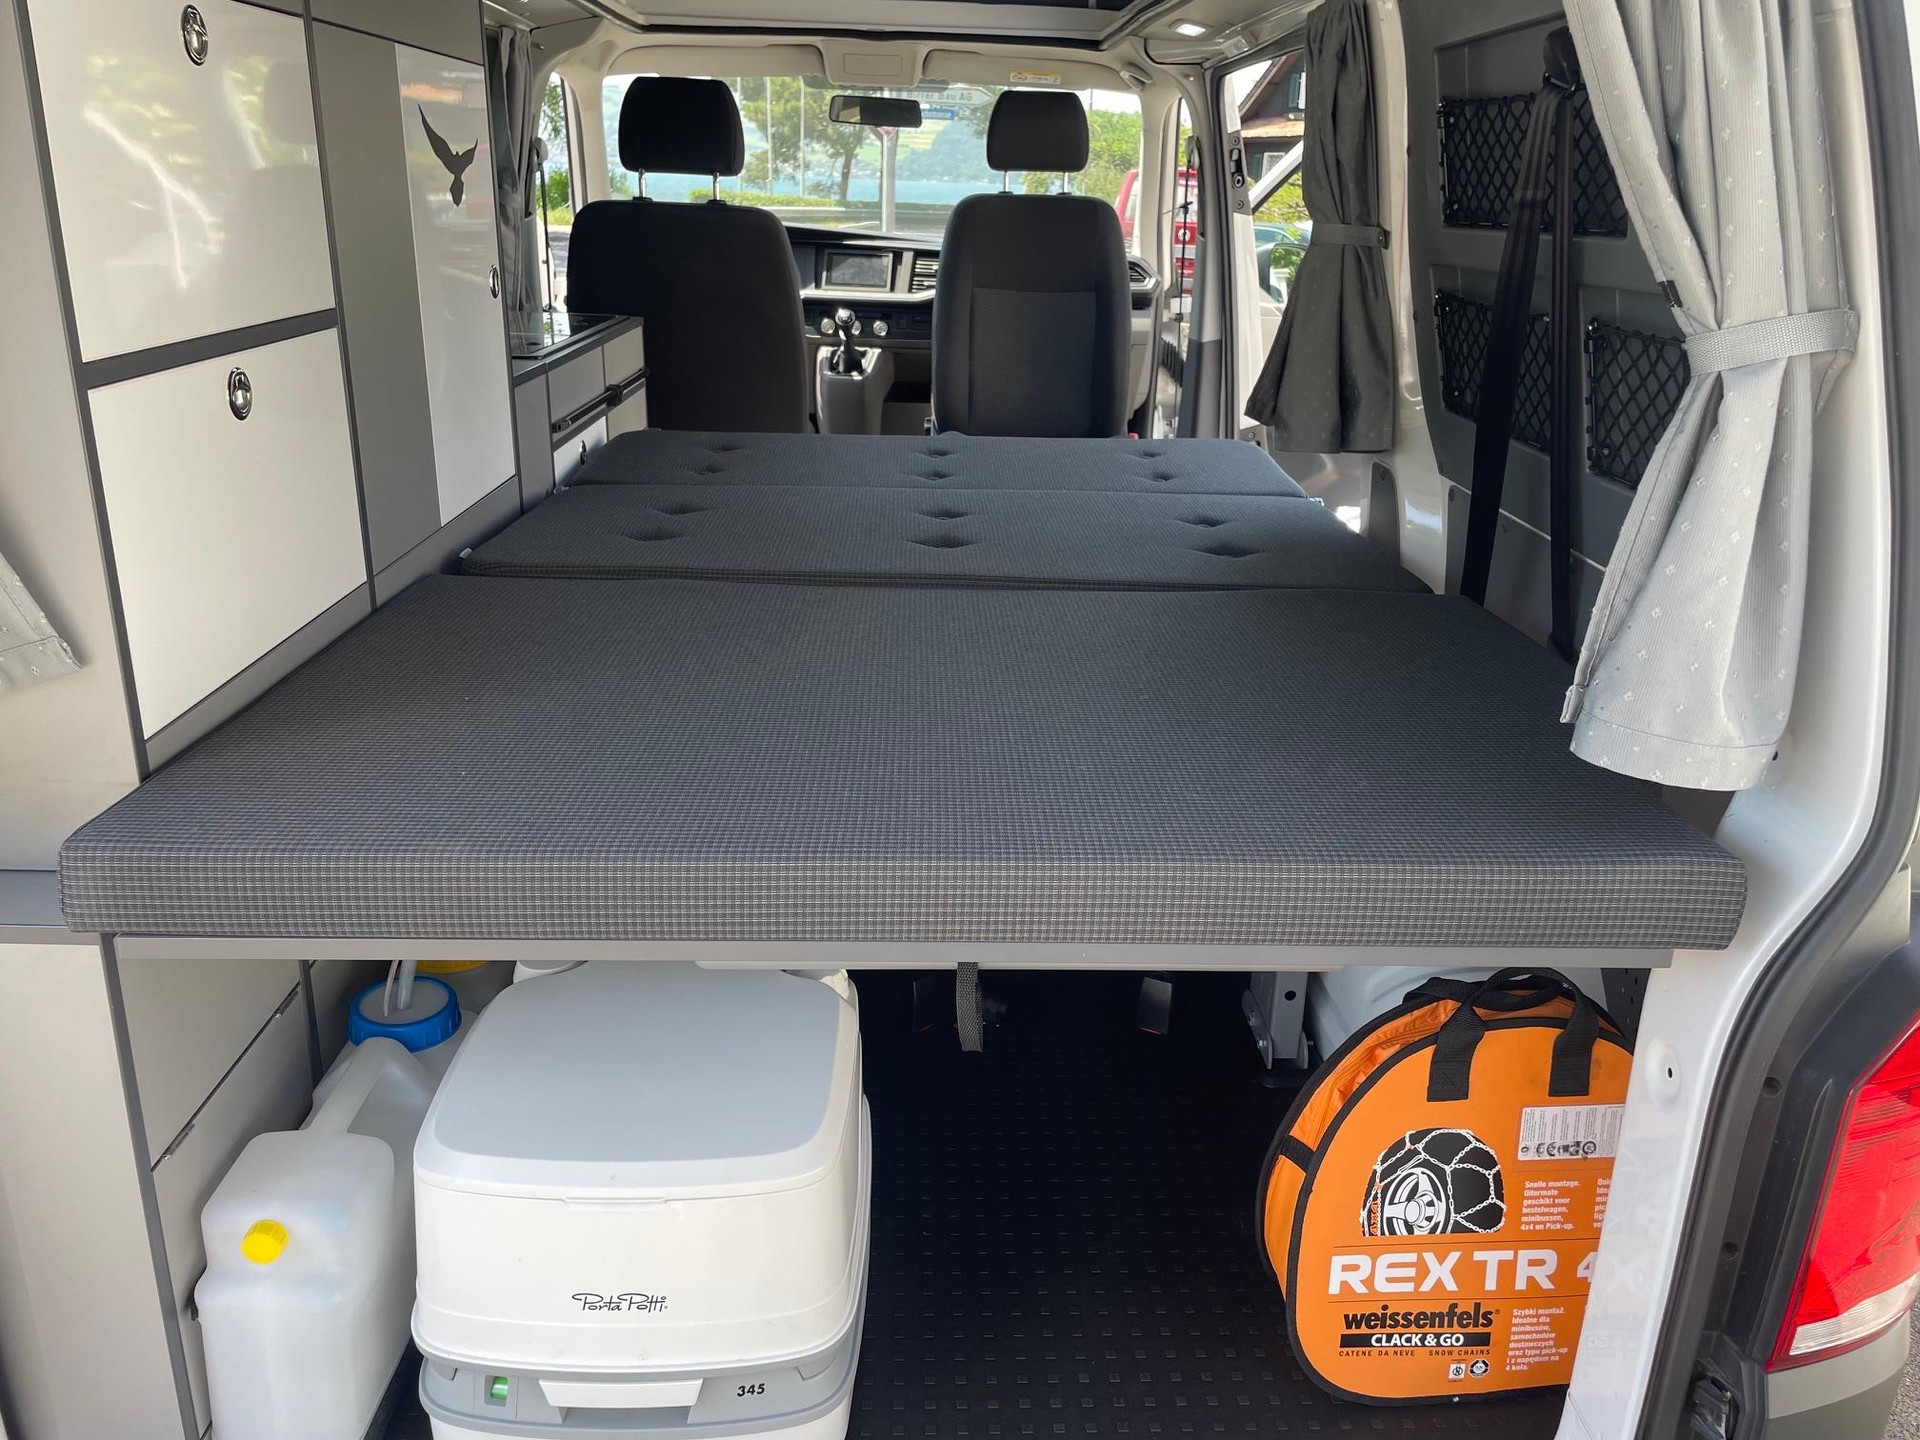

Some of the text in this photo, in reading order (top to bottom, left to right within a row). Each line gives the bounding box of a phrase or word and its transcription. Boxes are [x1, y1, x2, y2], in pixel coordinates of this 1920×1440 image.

[958, 92, 974, 102] AG
[1525, 1181, 1580, 1189] Snelle montage.
[1523, 1198, 1554, 1207] geschikt
[1522, 1206, 1569, 1214] bestelwagen,
[1545, 1222, 1575, 1232] Pick-up.
[1328, 1249, 1599, 1295] REX TR 4
[572, 1292, 667, 1313] Porta Potti
[1343, 1302, 1494, 1330] weissenfels
[1513, 1308, 1537, 1317] Szybki
[1371, 1333, 1465, 1347] CLACK & GO
[1510, 1332, 1556, 1340] samochodów
[1509, 1340, 1554, 1348] dostawczych
[1429, 1349, 1454, 1357] SNOW
[1458, 1348, 1491, 1356] CHAINS
[1541, 1347, 1568, 1355] pick-up
[737, 1383, 766, 1397] 345
